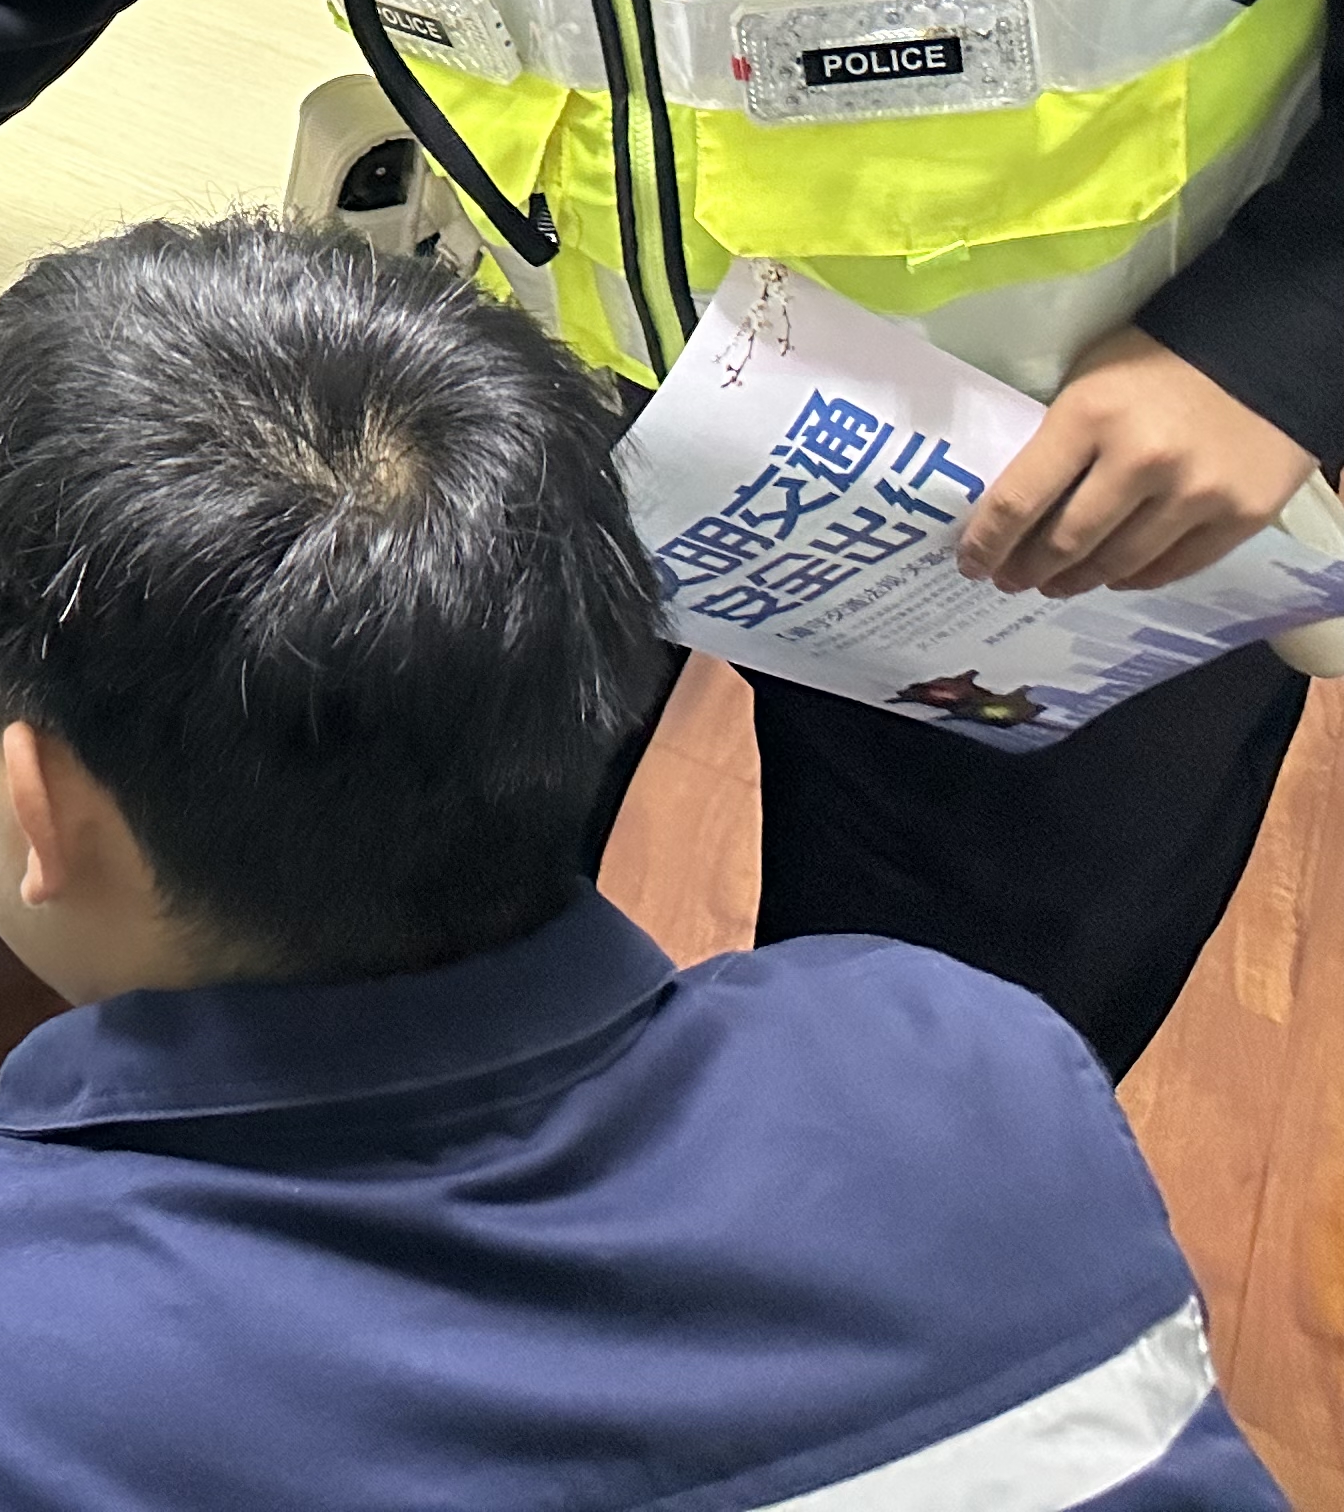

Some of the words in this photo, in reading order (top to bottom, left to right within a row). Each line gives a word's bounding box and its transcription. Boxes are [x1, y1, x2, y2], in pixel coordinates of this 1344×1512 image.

[378, 7, 442, 40] OLICE
[822, 45, 947, 79] POLICE
[689, 431, 986, 629] 安全出行
